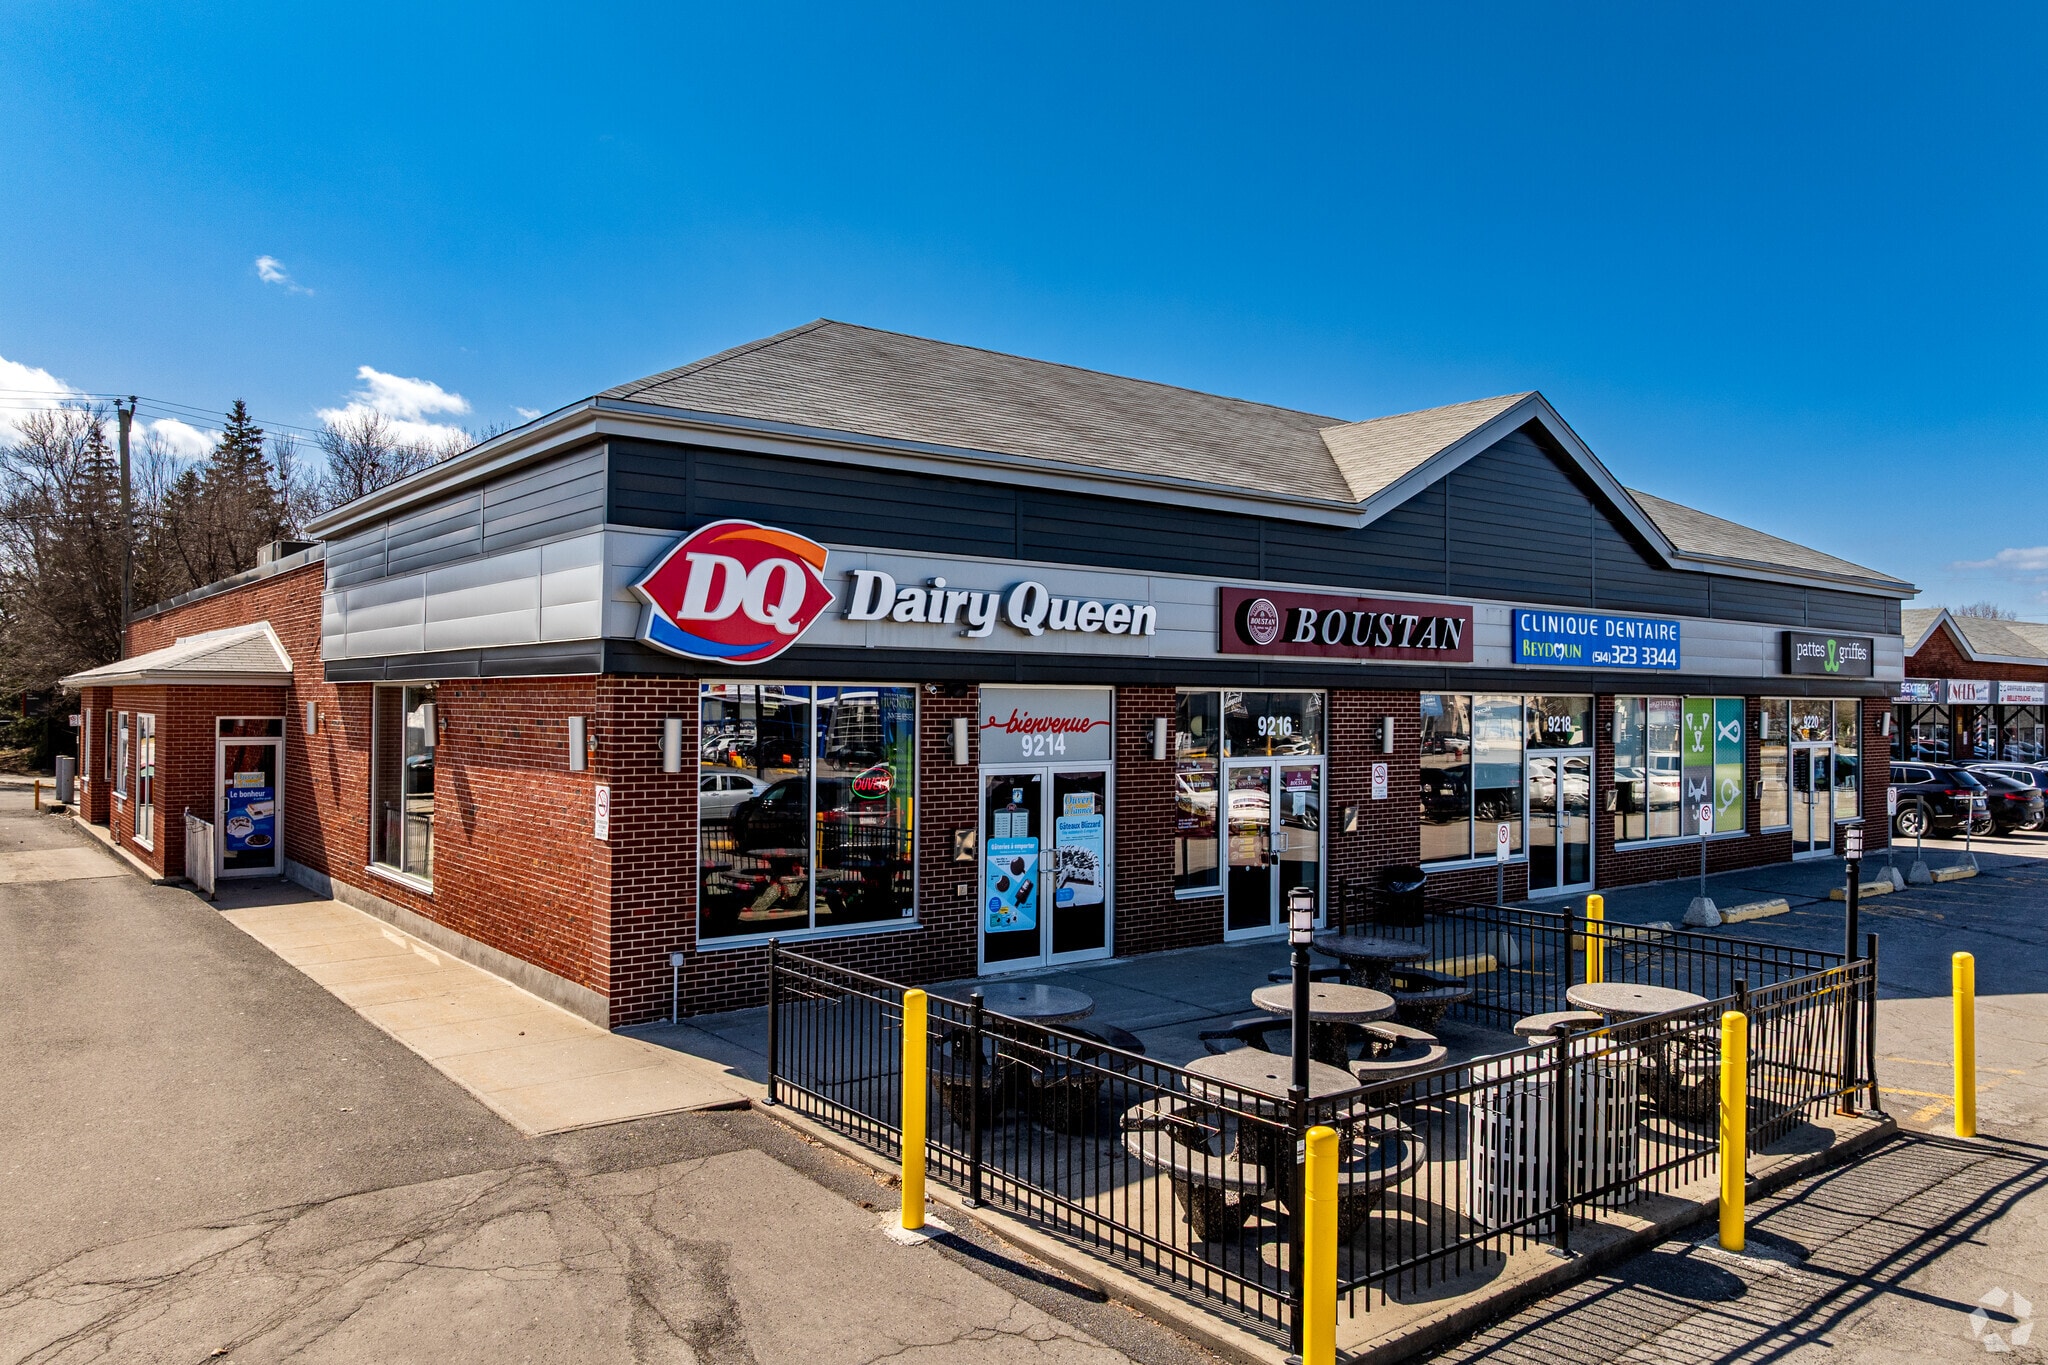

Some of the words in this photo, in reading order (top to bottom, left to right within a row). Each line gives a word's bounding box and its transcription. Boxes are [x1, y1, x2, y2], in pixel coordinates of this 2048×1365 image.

[677, 552, 807, 634] DQ
[845, 569, 1000, 638] Dairy
[1006, 581, 1157, 637] Queen
[1292, 607, 1466, 650] BOUSTAN
[1520, 613, 1599, 636] CLINIQUE
[1605, 620, 1677, 641] DENTAIRE
[1522, 639, 1582, 661] BEYDOUN
[1641, 647, 1677, 666] 3344
[1796, 641, 1825, 660] pattes
[1839, 642, 1867, 664] griffes
[980, 708, 1110, 734] bienvenue
[1257, 715, 1293, 737] 9216
[1547, 715, 1572, 733] 9218
[1803, 715, 1819, 729] 9220
[1021, 732, 1066, 757] 9214
[229, 790, 238, 798] Le
[239, 790, 266, 798] bonheur
